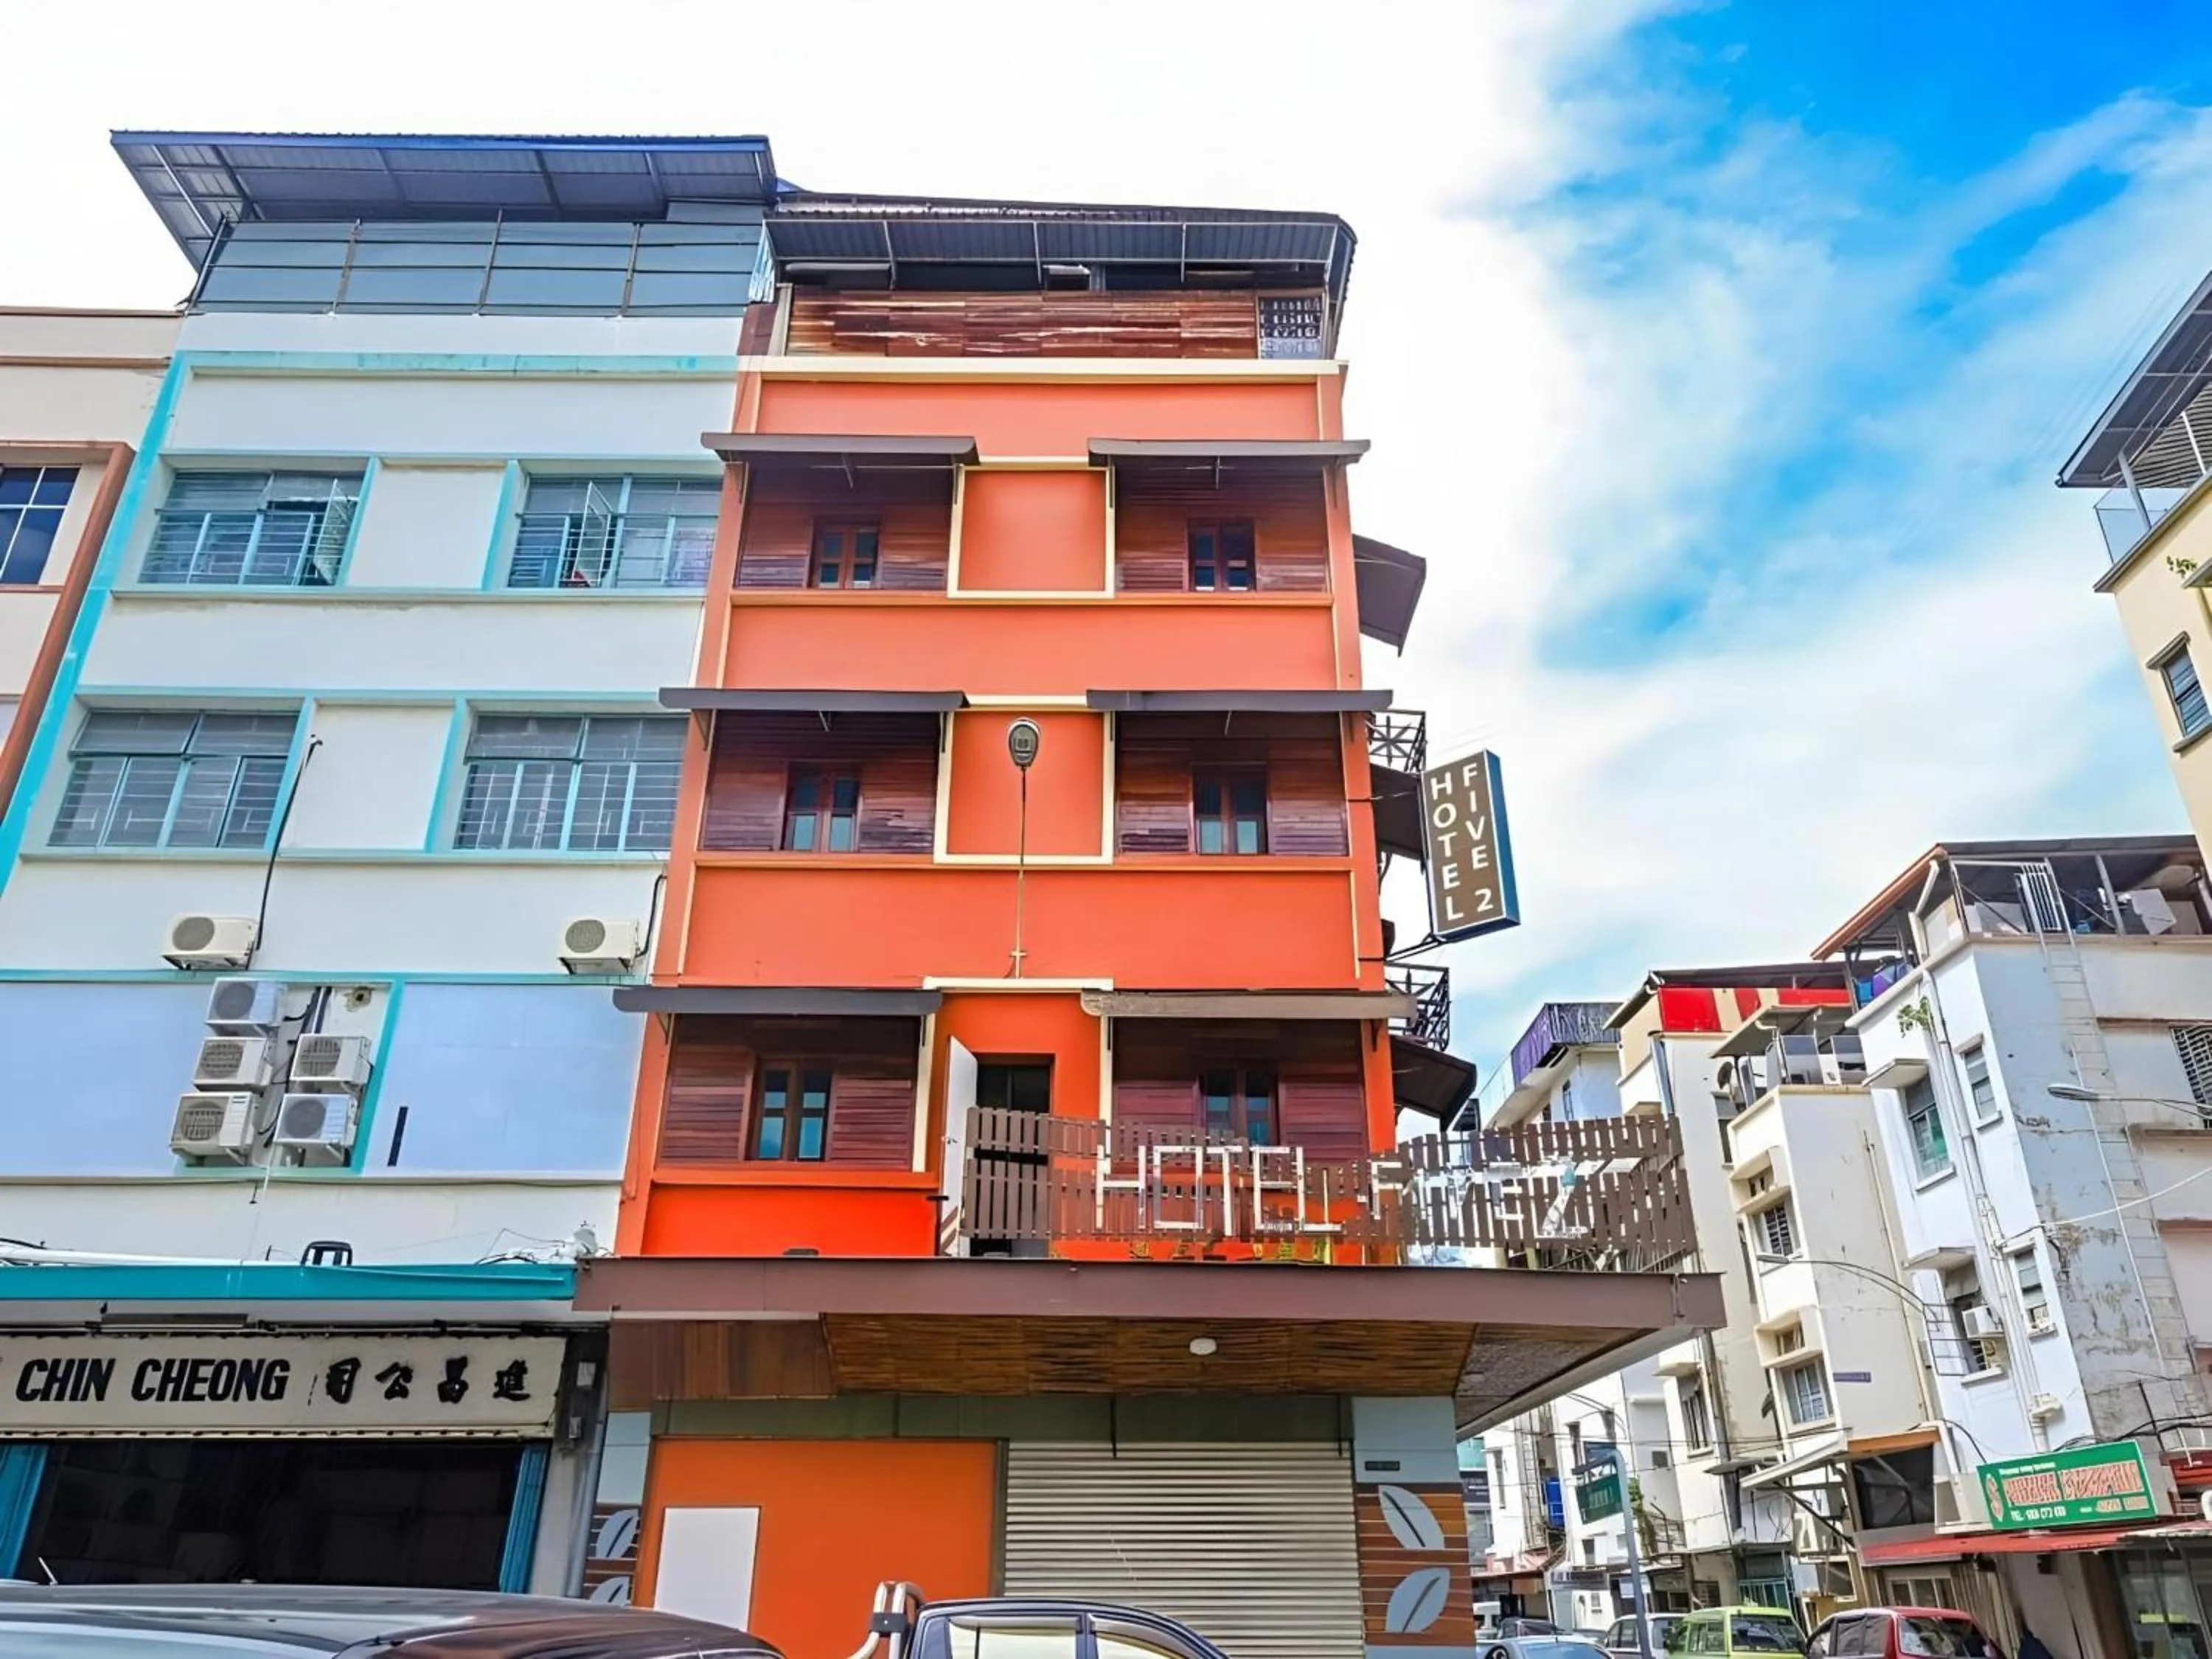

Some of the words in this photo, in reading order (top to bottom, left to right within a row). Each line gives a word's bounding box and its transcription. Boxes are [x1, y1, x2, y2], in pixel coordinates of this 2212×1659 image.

[1430, 771, 1464, 921] HOTEL
[1462, 762, 1489, 870] FIVE
[1096, 1143, 1343, 1237] HOTEL
[15, 1357, 116, 1402] CHIN
[131, 1357, 291, 1402] CHEONG
